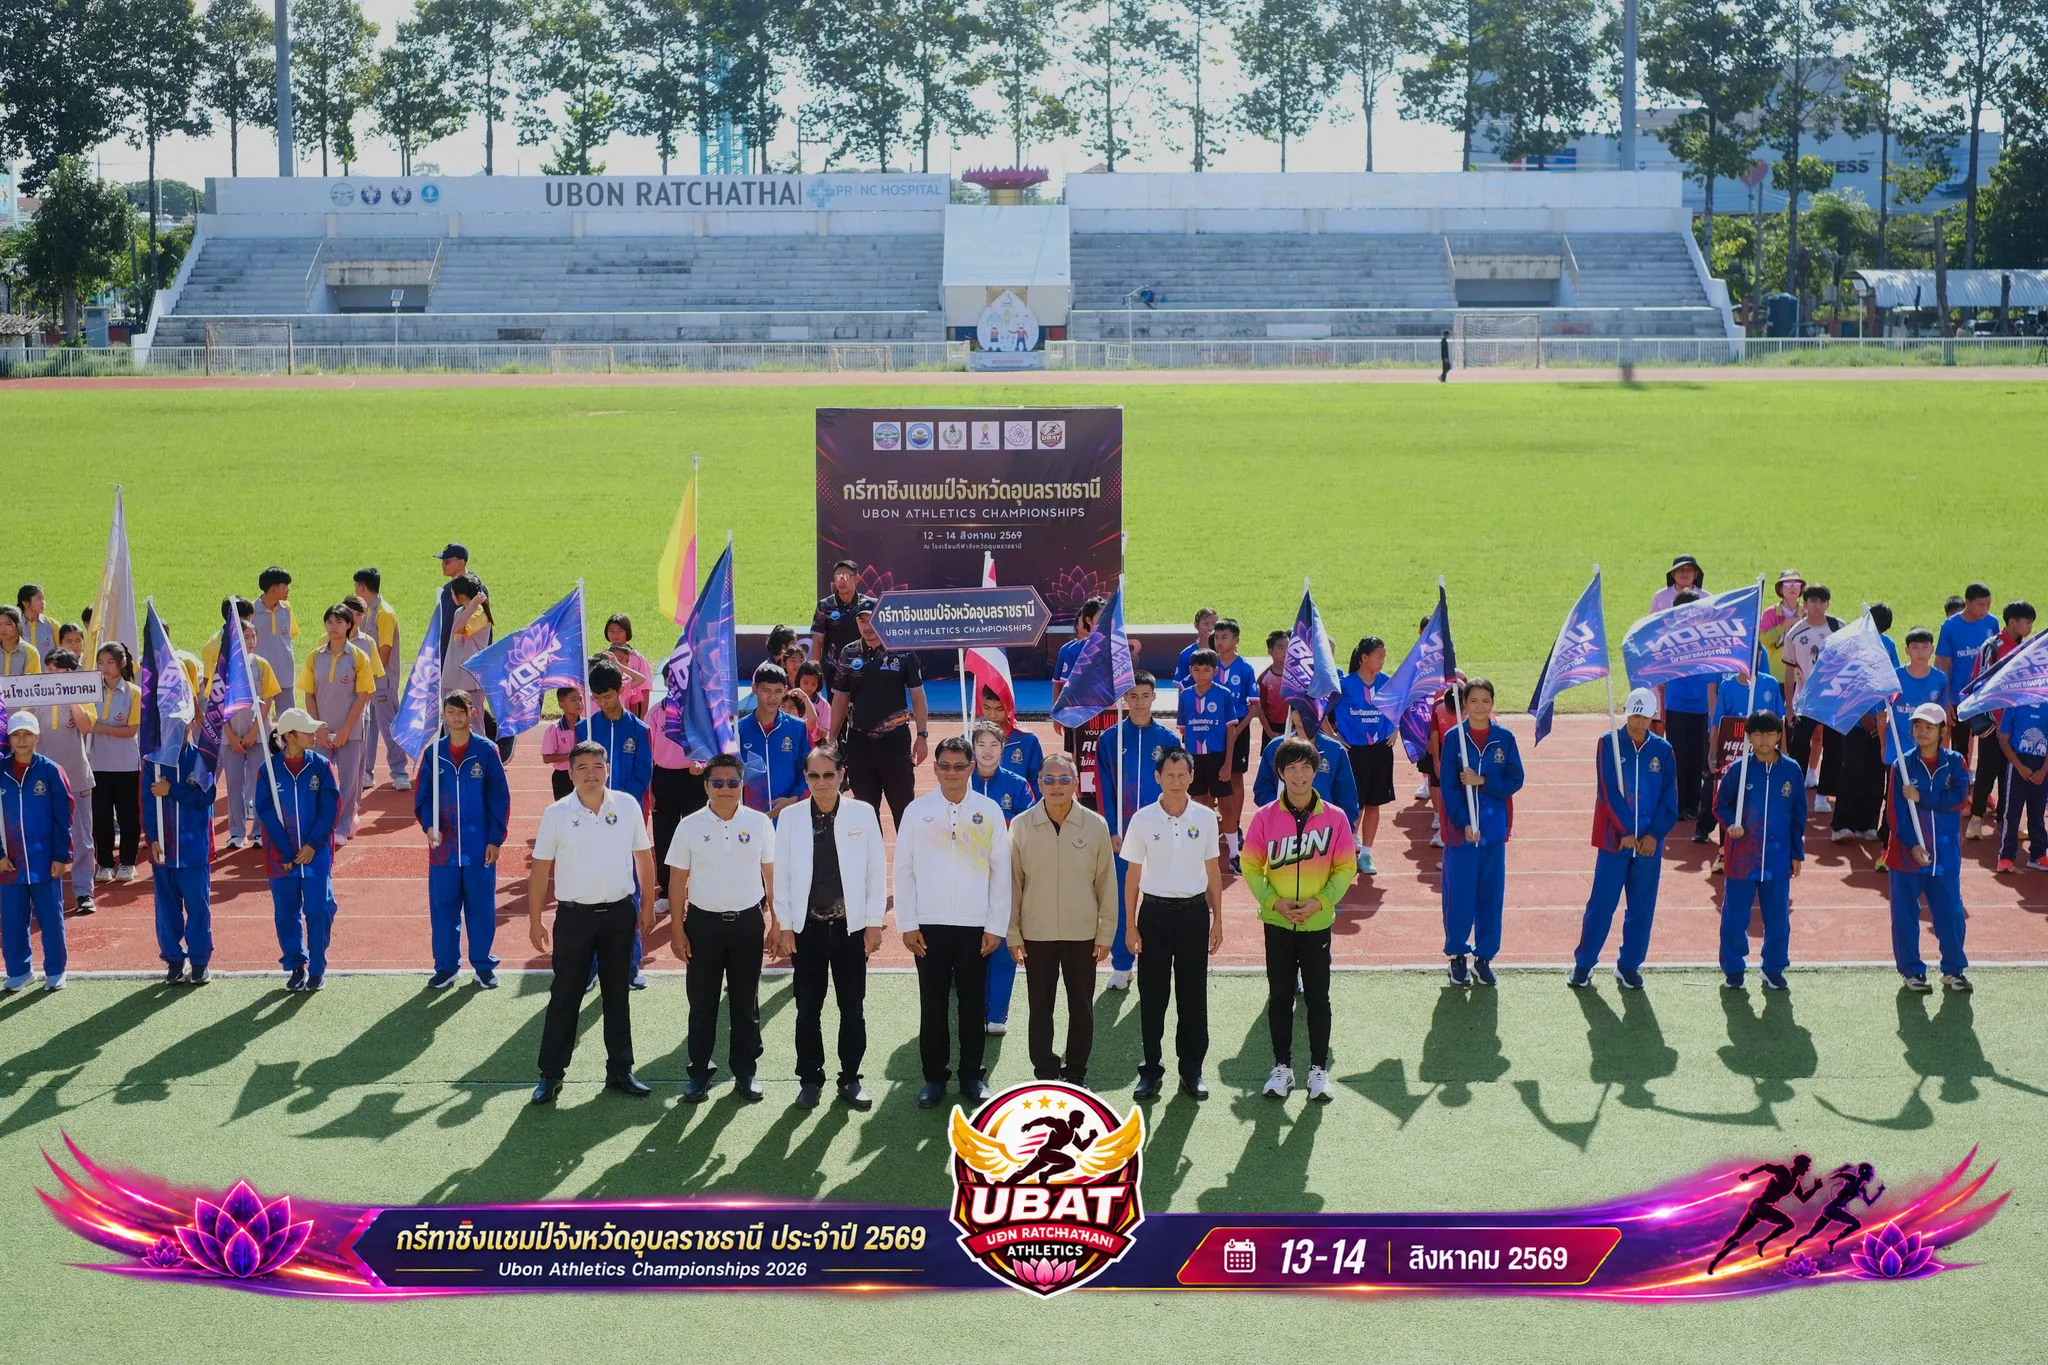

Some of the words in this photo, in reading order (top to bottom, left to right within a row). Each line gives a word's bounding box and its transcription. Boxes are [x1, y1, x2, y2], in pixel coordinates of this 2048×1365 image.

[546, 181, 624, 207] UBON
[881, 184, 942, 196] HOSPITAL
[862, 508, 900, 519] UBON
[905, 508, 977, 519] ATHLETICS
[982, 507, 1085, 519] CHAMPIONSHIPS
[923, 531, 934, 540] 12
[946, 531, 957, 540] 14
[960, 530, 997, 540] สิงหาคม
[999, 531, 1023, 540] 2569
[885, 629, 911, 637] UBON
[913, 626, 961, 636] ATHLETICS
[963, 623, 1033, 635] CHAMPIONSHIPS
[0, 682, 97, 700] นโขงเจียมวิทยาคม
